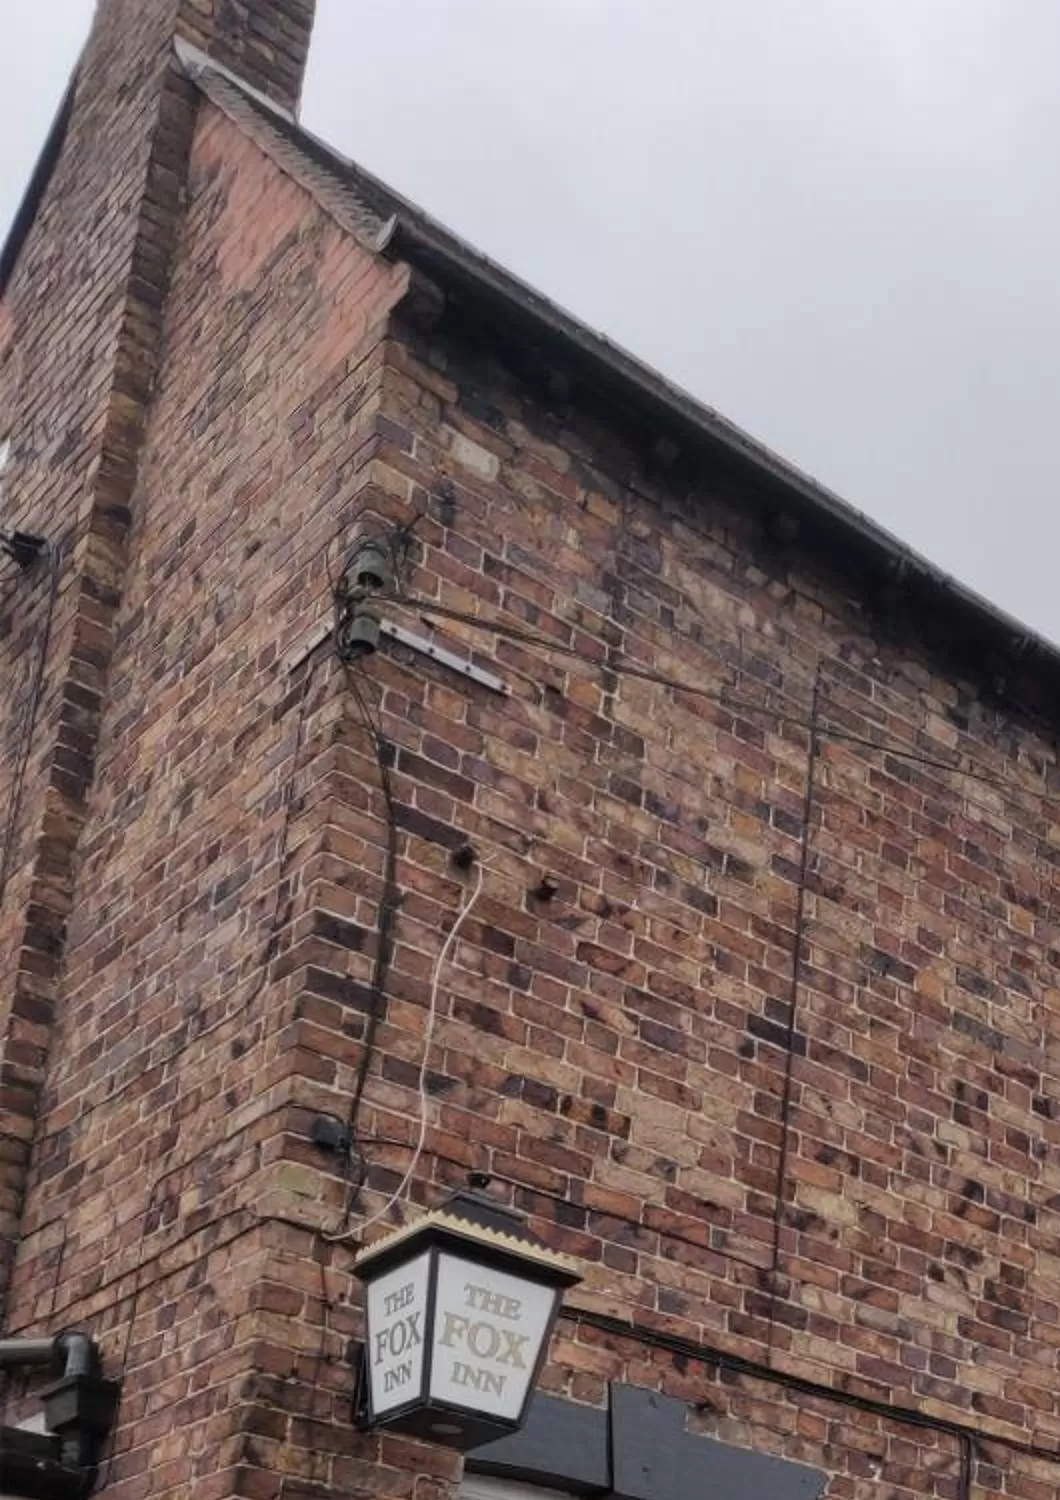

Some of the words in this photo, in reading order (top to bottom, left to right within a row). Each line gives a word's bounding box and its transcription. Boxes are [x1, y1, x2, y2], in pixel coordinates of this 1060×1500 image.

[384, 1282, 415, 1317] THE
[463, 1284, 522, 1321] THE
[374, 1311, 422, 1366] FOX
[438, 1311, 531, 1370] FOX
[384, 1360, 413, 1393] INN
[451, 1362, 507, 1397] INN
